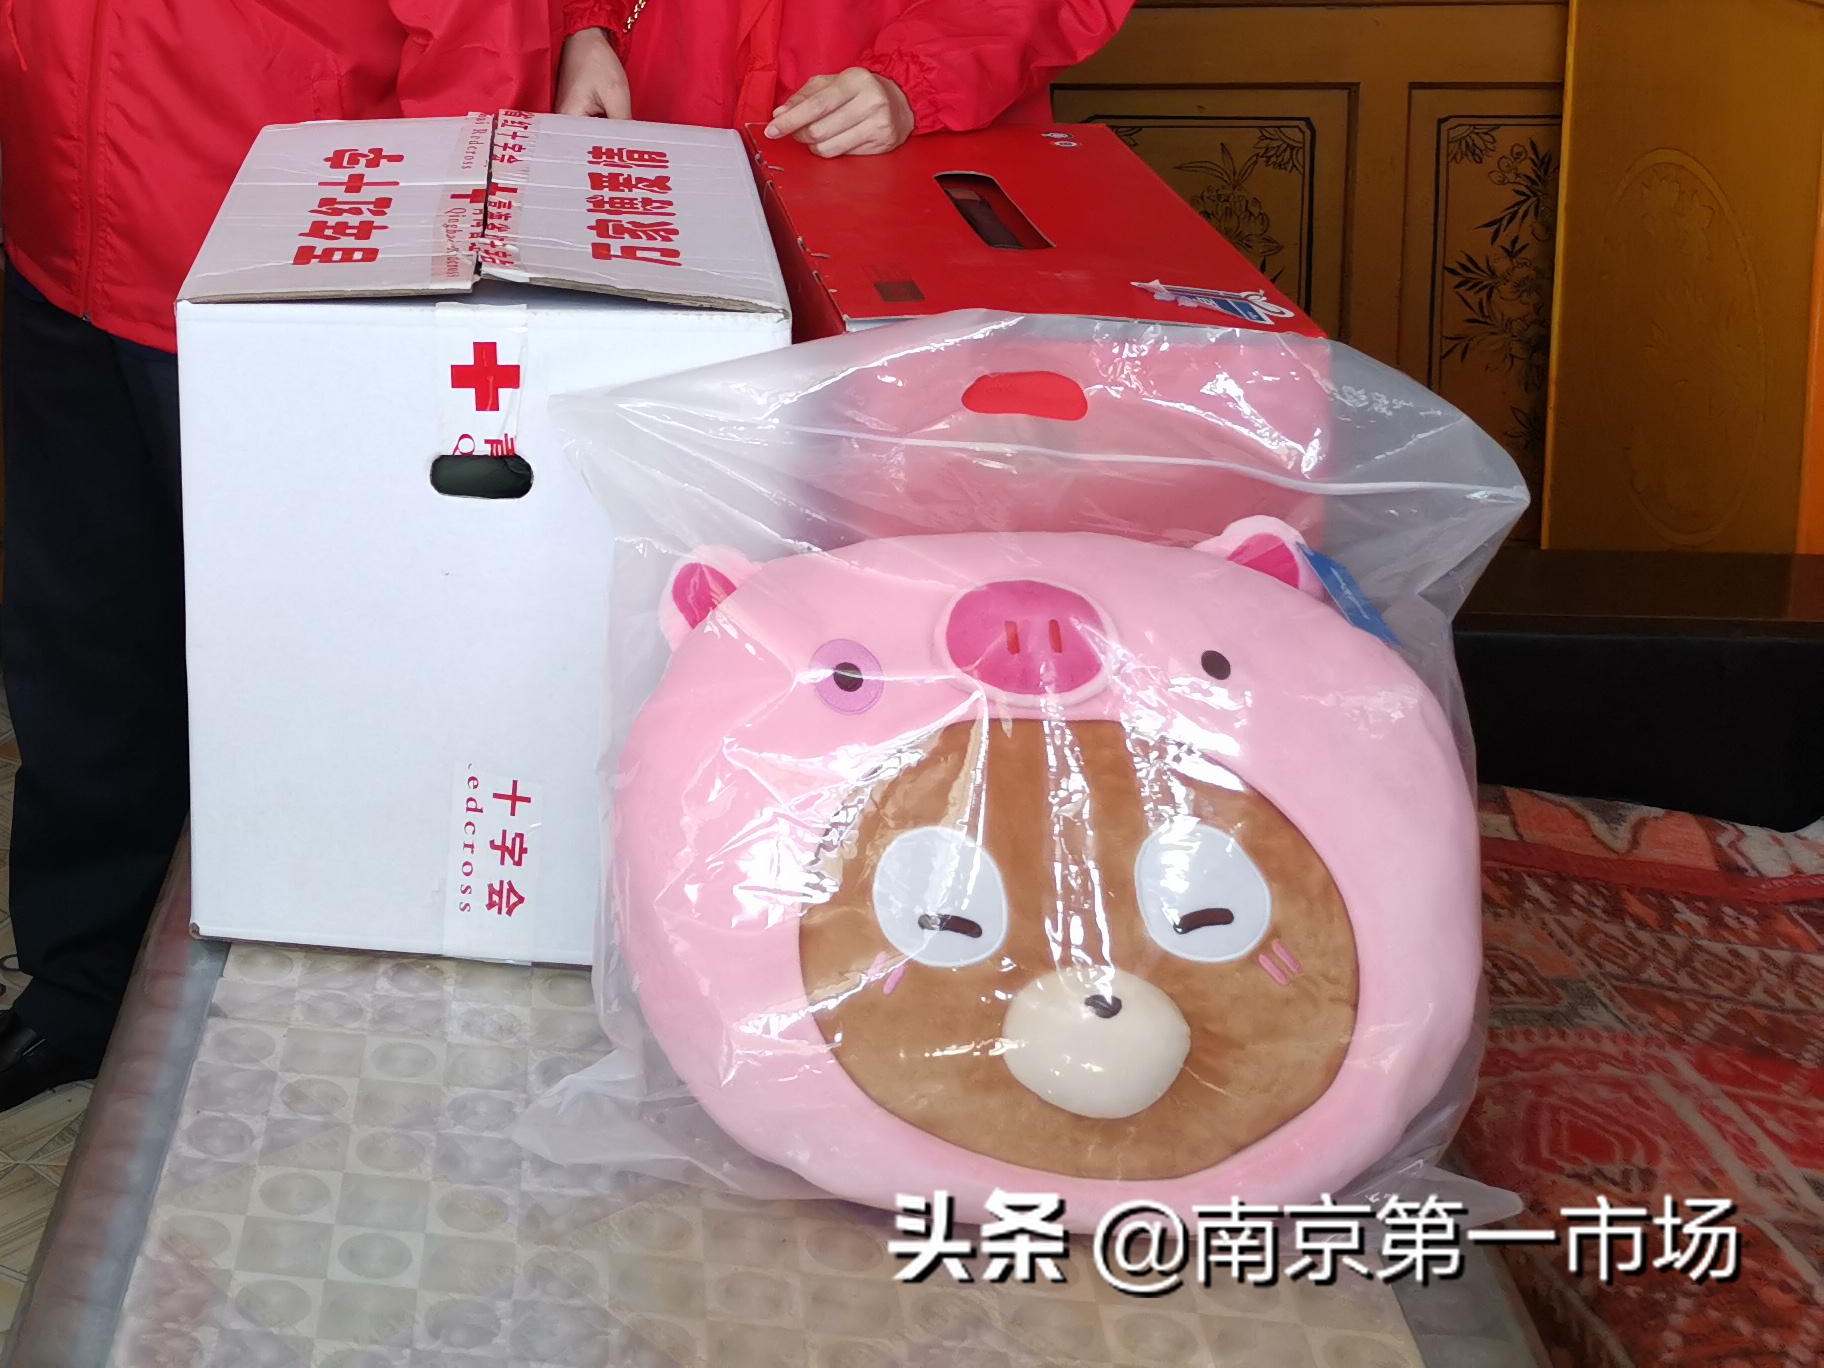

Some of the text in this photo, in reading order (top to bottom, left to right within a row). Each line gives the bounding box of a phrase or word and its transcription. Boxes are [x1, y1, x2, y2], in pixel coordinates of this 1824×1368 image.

[292, 147, 404, 266] 百年红十字
[459, 763, 484, 913] edcross
[485, 779, 532, 917] 十字会
